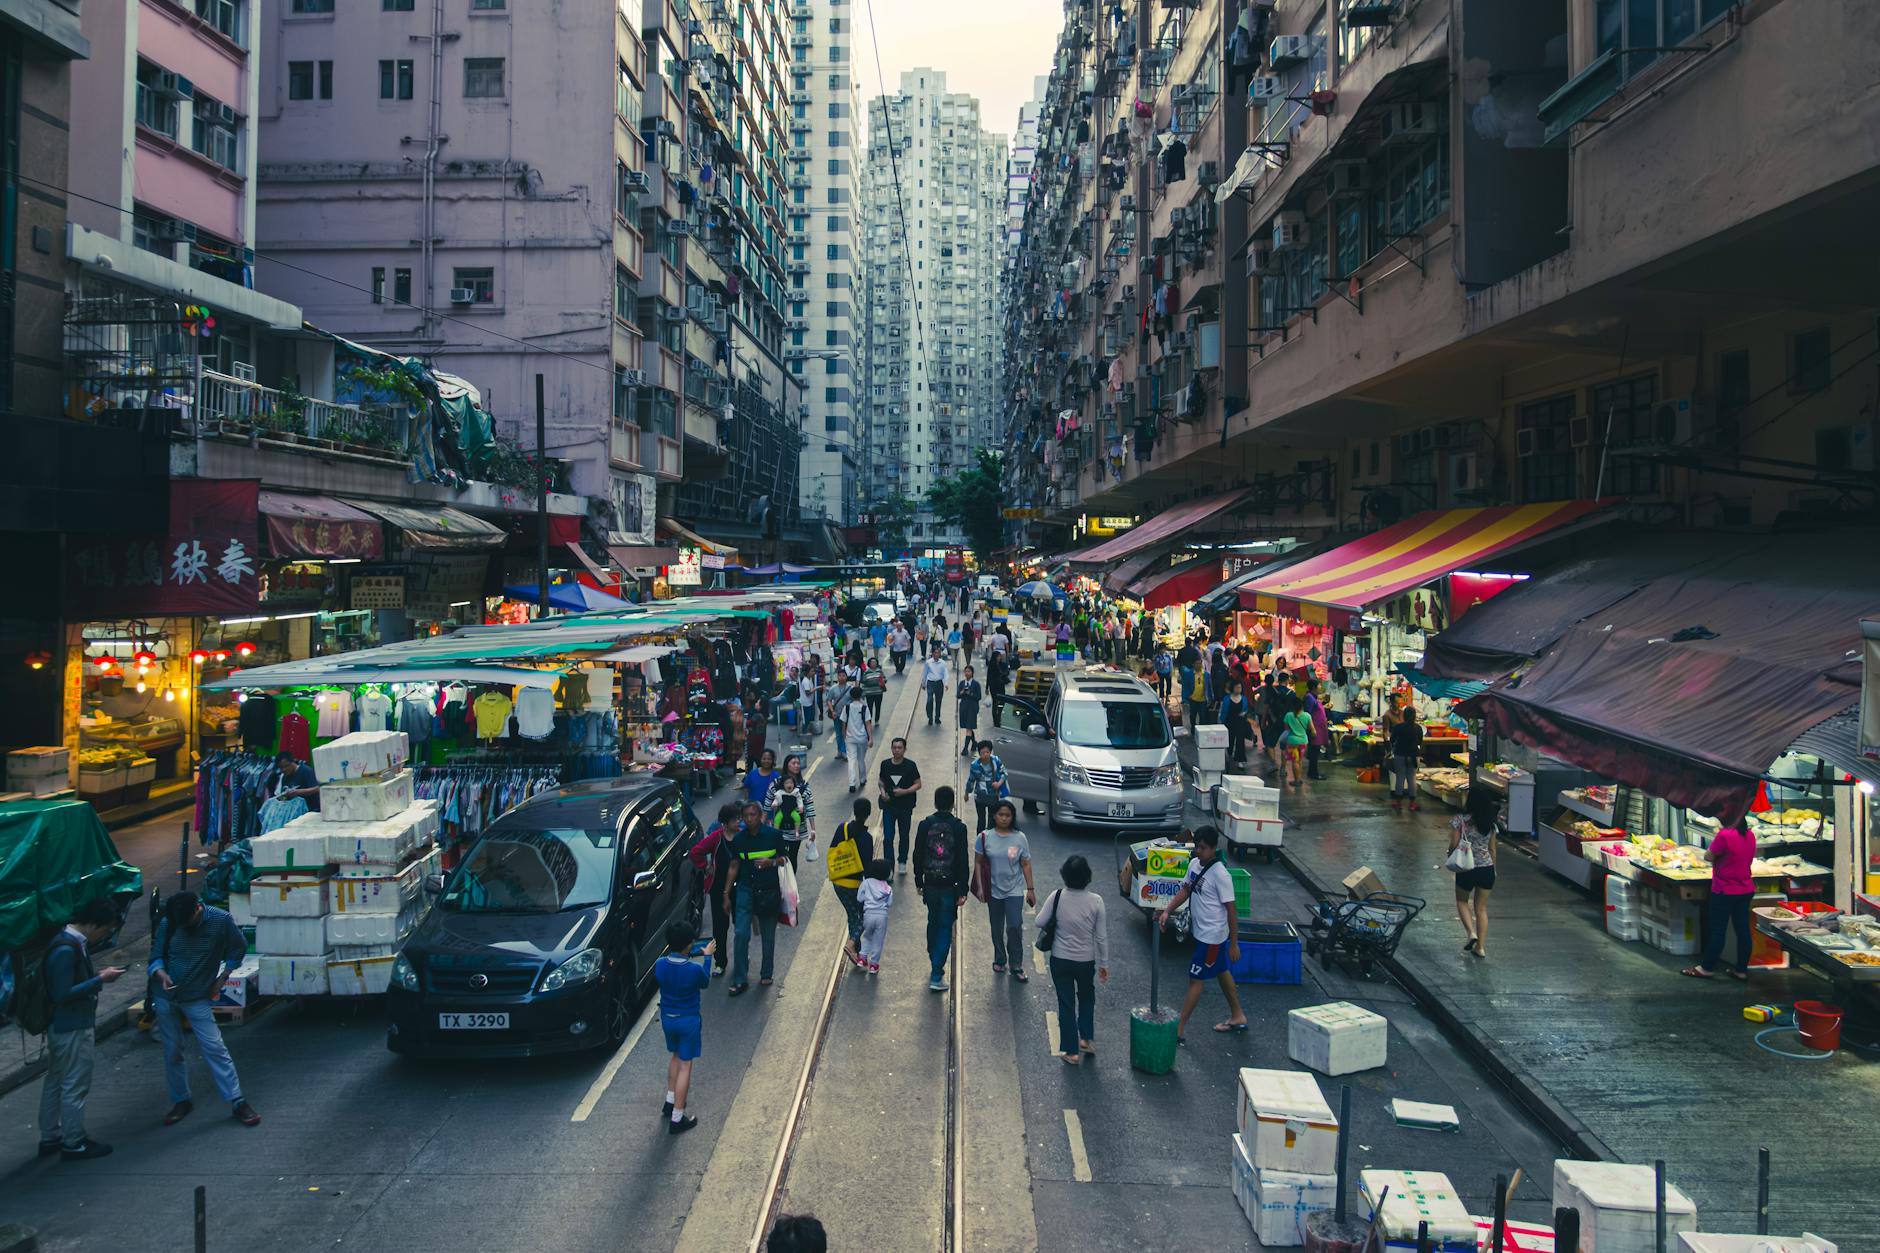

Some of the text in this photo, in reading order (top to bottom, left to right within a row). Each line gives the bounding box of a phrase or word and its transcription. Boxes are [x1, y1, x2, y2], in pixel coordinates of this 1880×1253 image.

[1190, 963, 1203, 976] 17
[442, 1014, 506, 1027] TX 3290
